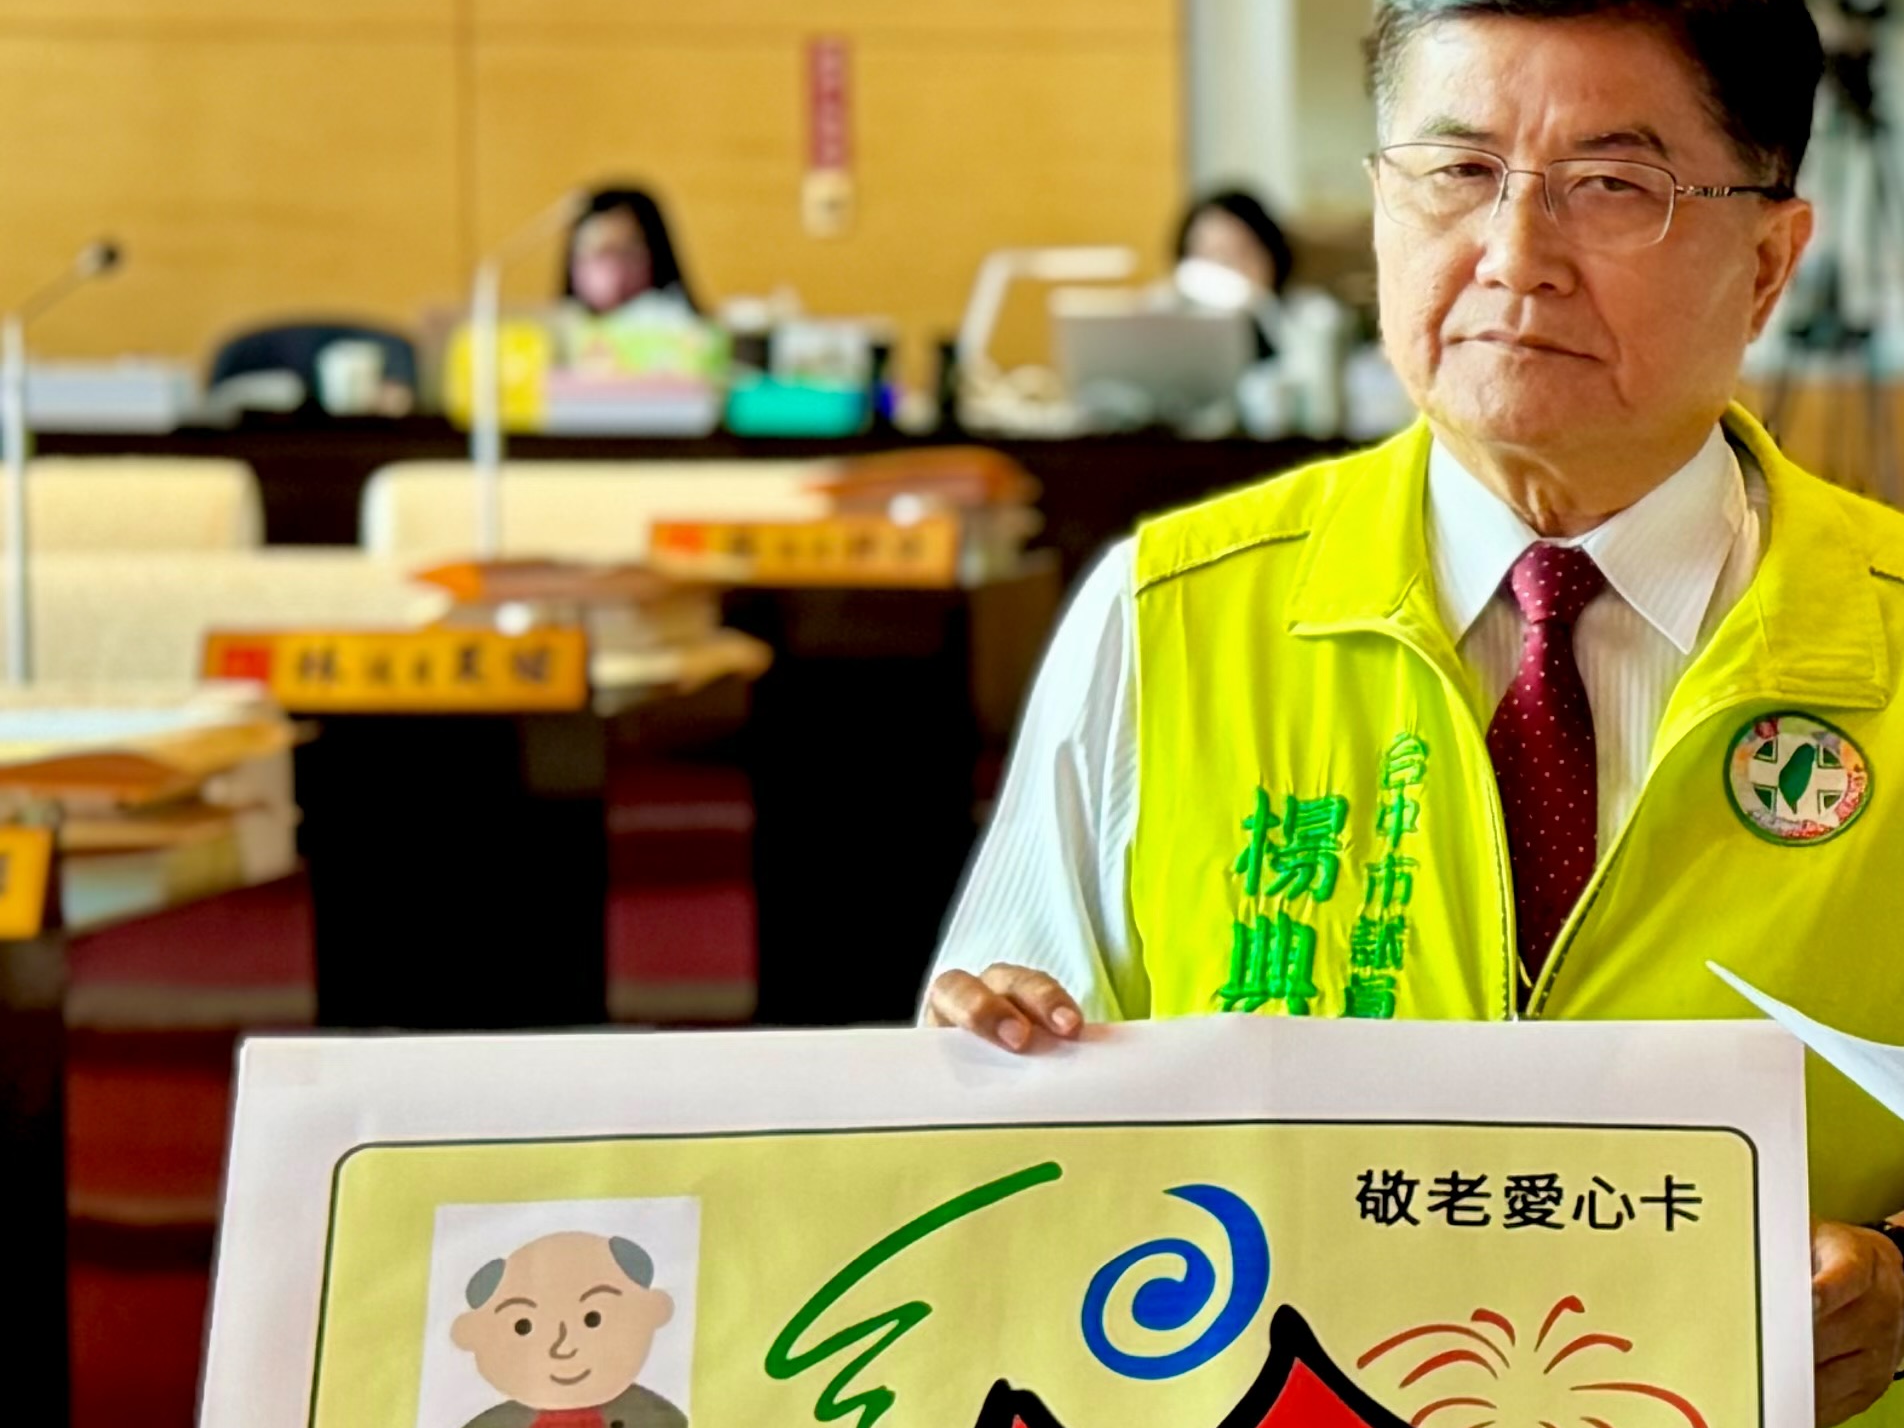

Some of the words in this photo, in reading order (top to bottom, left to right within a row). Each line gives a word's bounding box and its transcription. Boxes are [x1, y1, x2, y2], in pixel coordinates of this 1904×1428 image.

[1217, 785, 1349, 1017] 楊典
[1354, 1168, 1704, 1233] 敬老愛心卡
